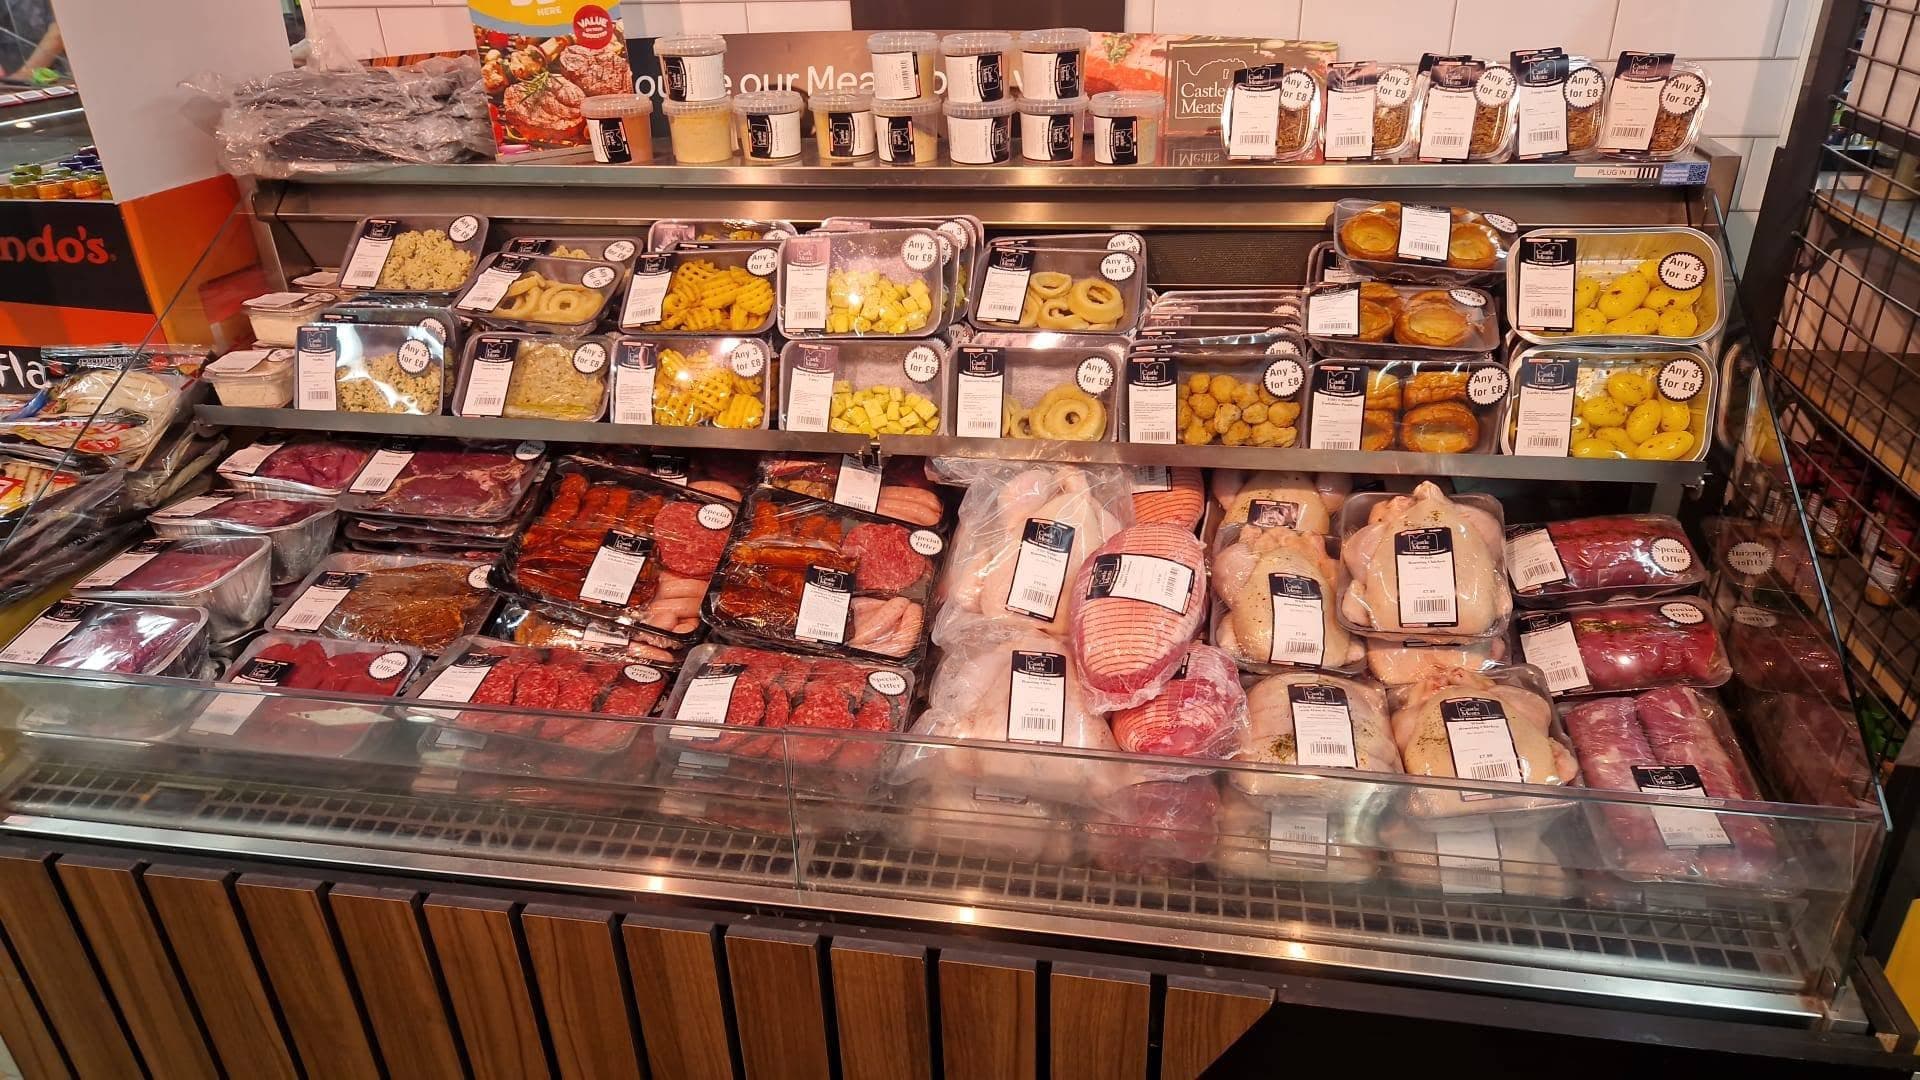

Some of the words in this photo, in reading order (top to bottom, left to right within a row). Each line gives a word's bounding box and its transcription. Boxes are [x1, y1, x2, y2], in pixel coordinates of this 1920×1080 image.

[537, 7, 562, 16] HERE
[577, 16, 608, 28] VALUE
[740, 73, 800, 94] our
[807, 65, 876, 96] Mea
[1284, 77, 1300, 90] Any
[1383, 74, 1400, 86] Any
[1404, 78, 1410, 86] 3
[1485, 72, 1501, 86] Any
[1506, 78, 1512, 86] 3
[1572, 75, 1590, 88] Any
[1594, 75, 1599, 84] 3
[1181, 82, 1226, 98] Castle
[1380, 86, 1392, 96] for
[1395, 90, 1406, 98] £8
[1672, 80, 1691, 93] Any
[1694, 84, 1700, 93] 3
[1281, 88, 1294, 98] for
[1296, 92, 1307, 101] £8
[1480, 86, 1492, 96] for
[1496, 90, 1508, 100] £8
[1570, 88, 1582, 98] for
[1587, 89, 1598, 98] £8
[1666, 94, 1680, 104] for
[1683, 97, 1696, 106] £8
[1181, 100, 1222, 114] Meats
[0, 223, 110, 264] ndo's
[909, 241, 925, 250] Any
[928, 241, 934, 250] 3
[1110, 240, 1125, 249] Any
[1129, 237, 1134, 245] 3
[752, 254, 768, 262] Any
[907, 252, 919, 262] for
[922, 254, 933, 262] £8
[1106, 258, 1122, 267] Any
[1126, 256, 1131, 264] 3
[1669, 257, 1690, 270] Any
[1694, 262, 1701, 272] 3
[1106, 268, 1117, 276] for
[1665, 268, 1680, 279] for
[1684, 272, 1698, 284] £8
[404, 344, 420, 356] Any
[582, 346, 594, 357] Any
[735, 350, 750, 360] Any
[401, 356, 414, 365] for
[416, 360, 424, 368] £8
[577, 356, 588, 365] for
[590, 360, 600, 368] £8
[912, 352, 928, 362] Any
[737, 362, 748, 370] for
[751, 360, 761, 368] £8
[910, 363, 922, 373] for
[925, 366, 936, 374] £8
[1086, 363, 1102, 374] Any
[1270, 368, 1287, 379] Any
[1292, 366, 1298, 374] 3
[1668, 365, 1689, 379] Any
[1692, 369, 1700, 378] 3
[1084, 376, 1095, 384] for
[1098, 378, 1110, 386] £8
[1270, 380, 1284, 390] for
[1288, 378, 1300, 386] £8
[1474, 374, 1492, 387] Any
[1496, 373, 1503, 381] 3
[1664, 378, 1678, 389] for
[1682, 382, 1696, 392] £8
[1474, 387, 1488, 396] for
[1491, 386, 1504, 395] £8
[703, 507, 730, 520] Special
[704, 514, 726, 526] Offer
[914, 534, 940, 546] Special
[916, 541, 938, 552] Offer
[1654, 546, 1686, 556] Special
[1662, 554, 1687, 564] Offer
[1662, 606, 1698, 615] Special
[1672, 611, 1698, 620] Offer
[380, 656, 406, 668] Special
[376, 664, 394, 674] Offer
[631, 665, 660, 677] Special
[632, 671, 656, 681] Offer
[872, 675, 900, 686] Special
[879, 682, 901, 690] Offer
